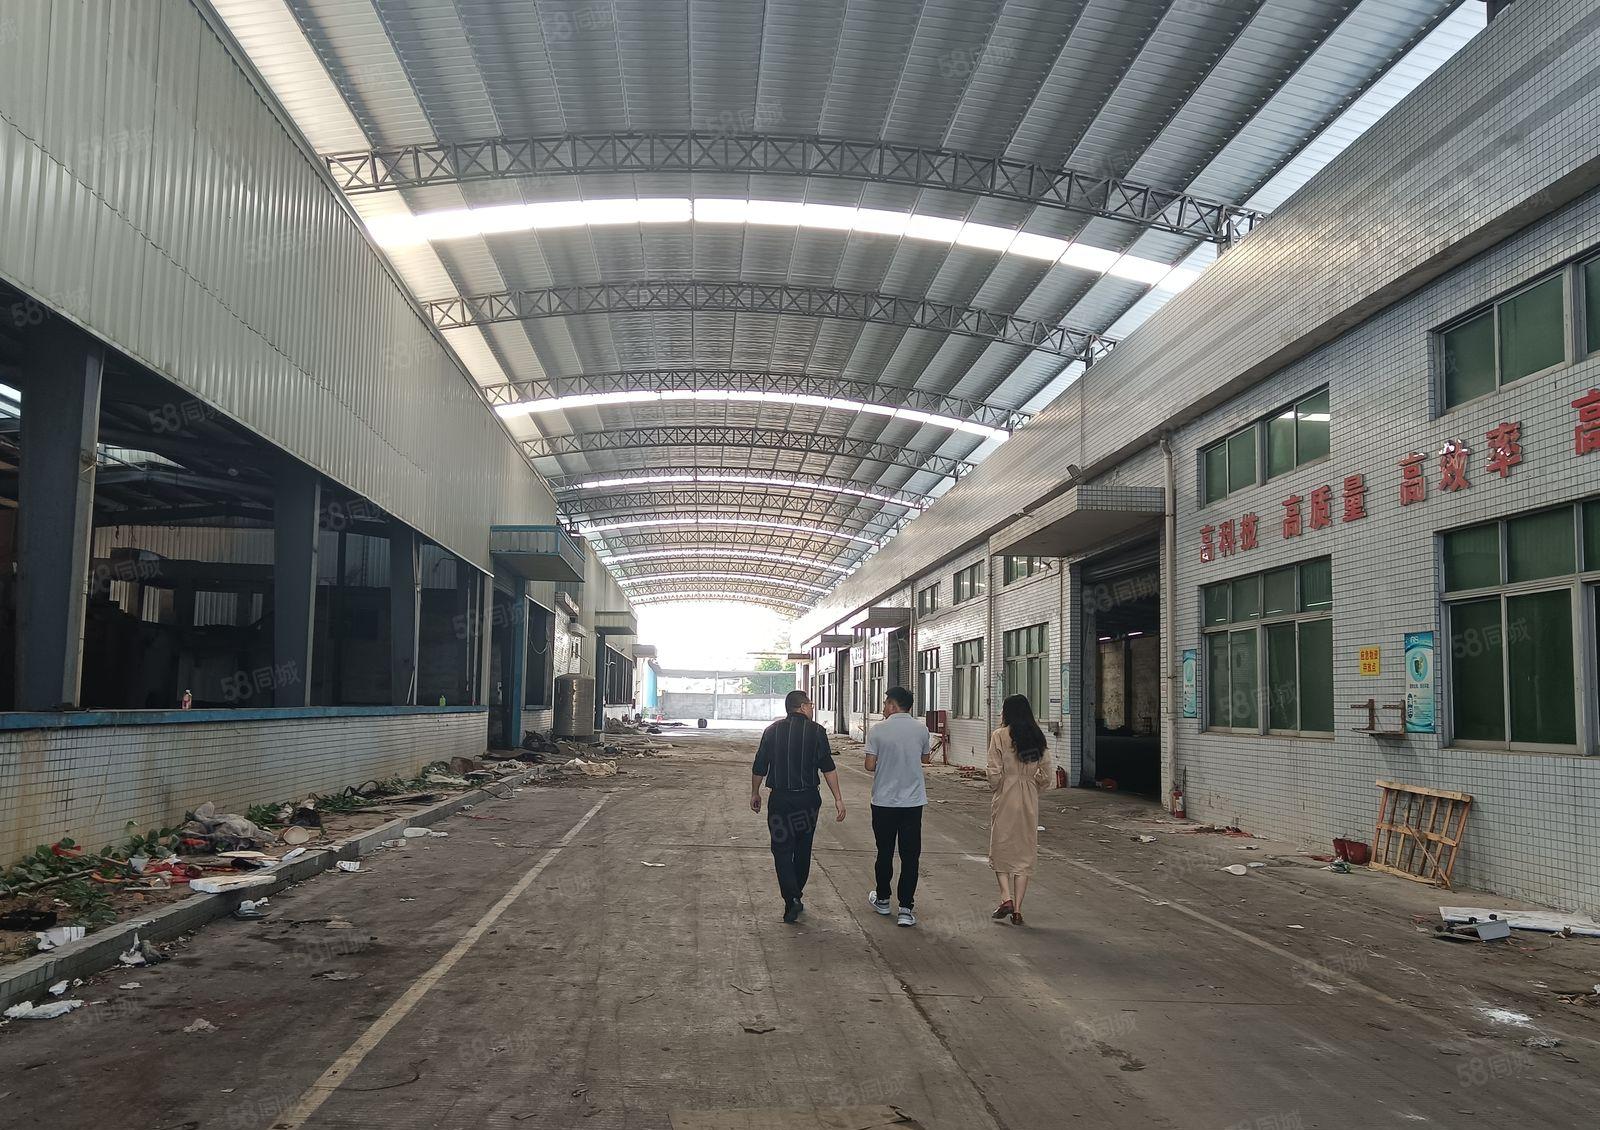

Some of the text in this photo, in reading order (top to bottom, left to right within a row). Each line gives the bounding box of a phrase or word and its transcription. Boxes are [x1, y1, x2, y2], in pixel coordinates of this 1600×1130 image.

[1200, 388, 1600, 563] 高科技 高质量 高效率 高
